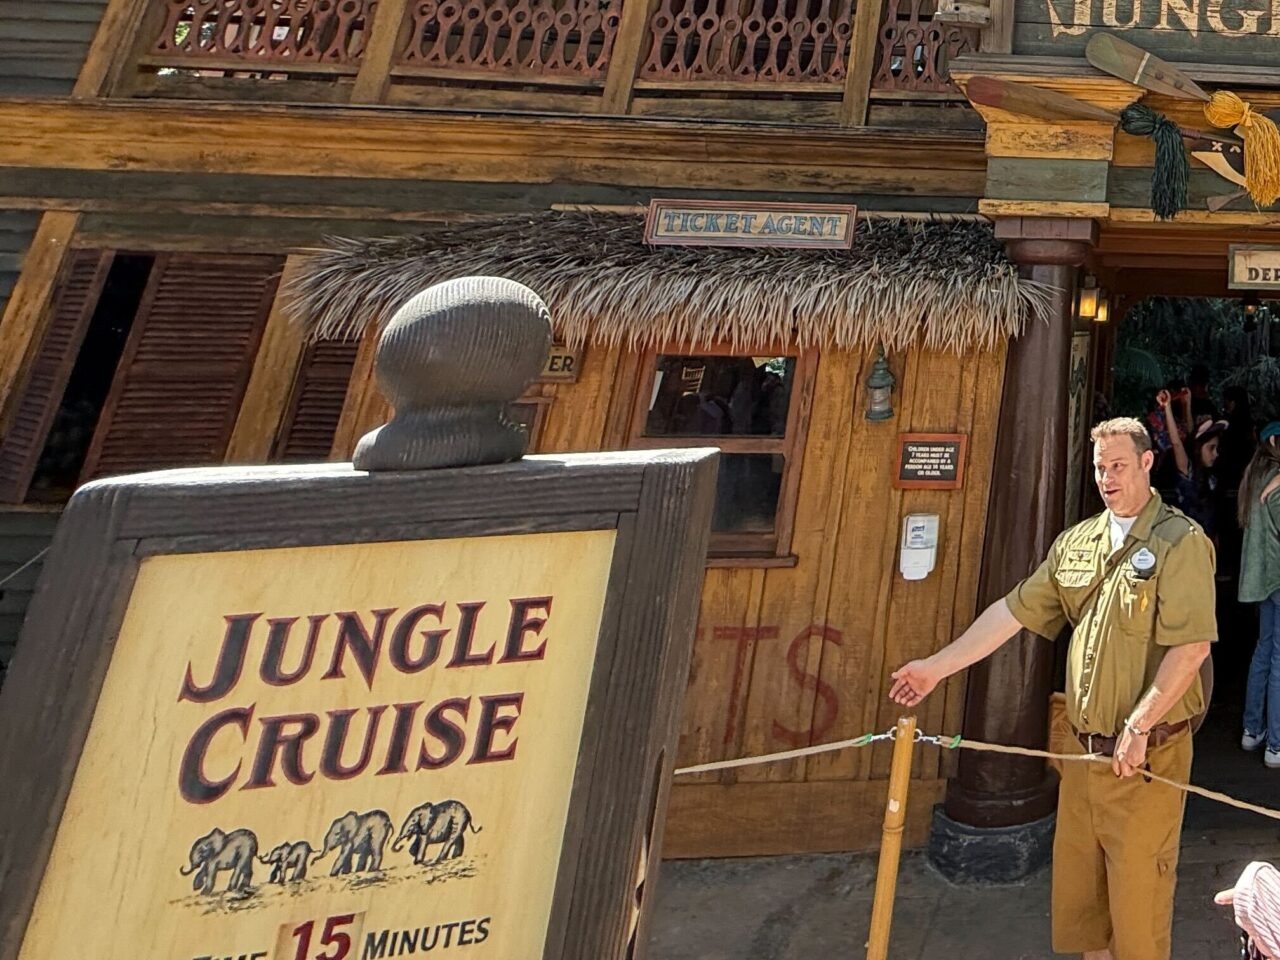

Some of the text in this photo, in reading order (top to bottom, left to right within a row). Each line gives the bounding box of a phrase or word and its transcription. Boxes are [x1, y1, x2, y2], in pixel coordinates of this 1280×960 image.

[664, 211, 841, 237] TICKET AGENT
[548, 355, 574, 372] ER
[177, 595, 554, 703] JUNGLE
[690, 623, 844, 746] TS
[178, 692, 525, 805] CRUISE
[292, 913, 492, 960] 15 MINUTES
